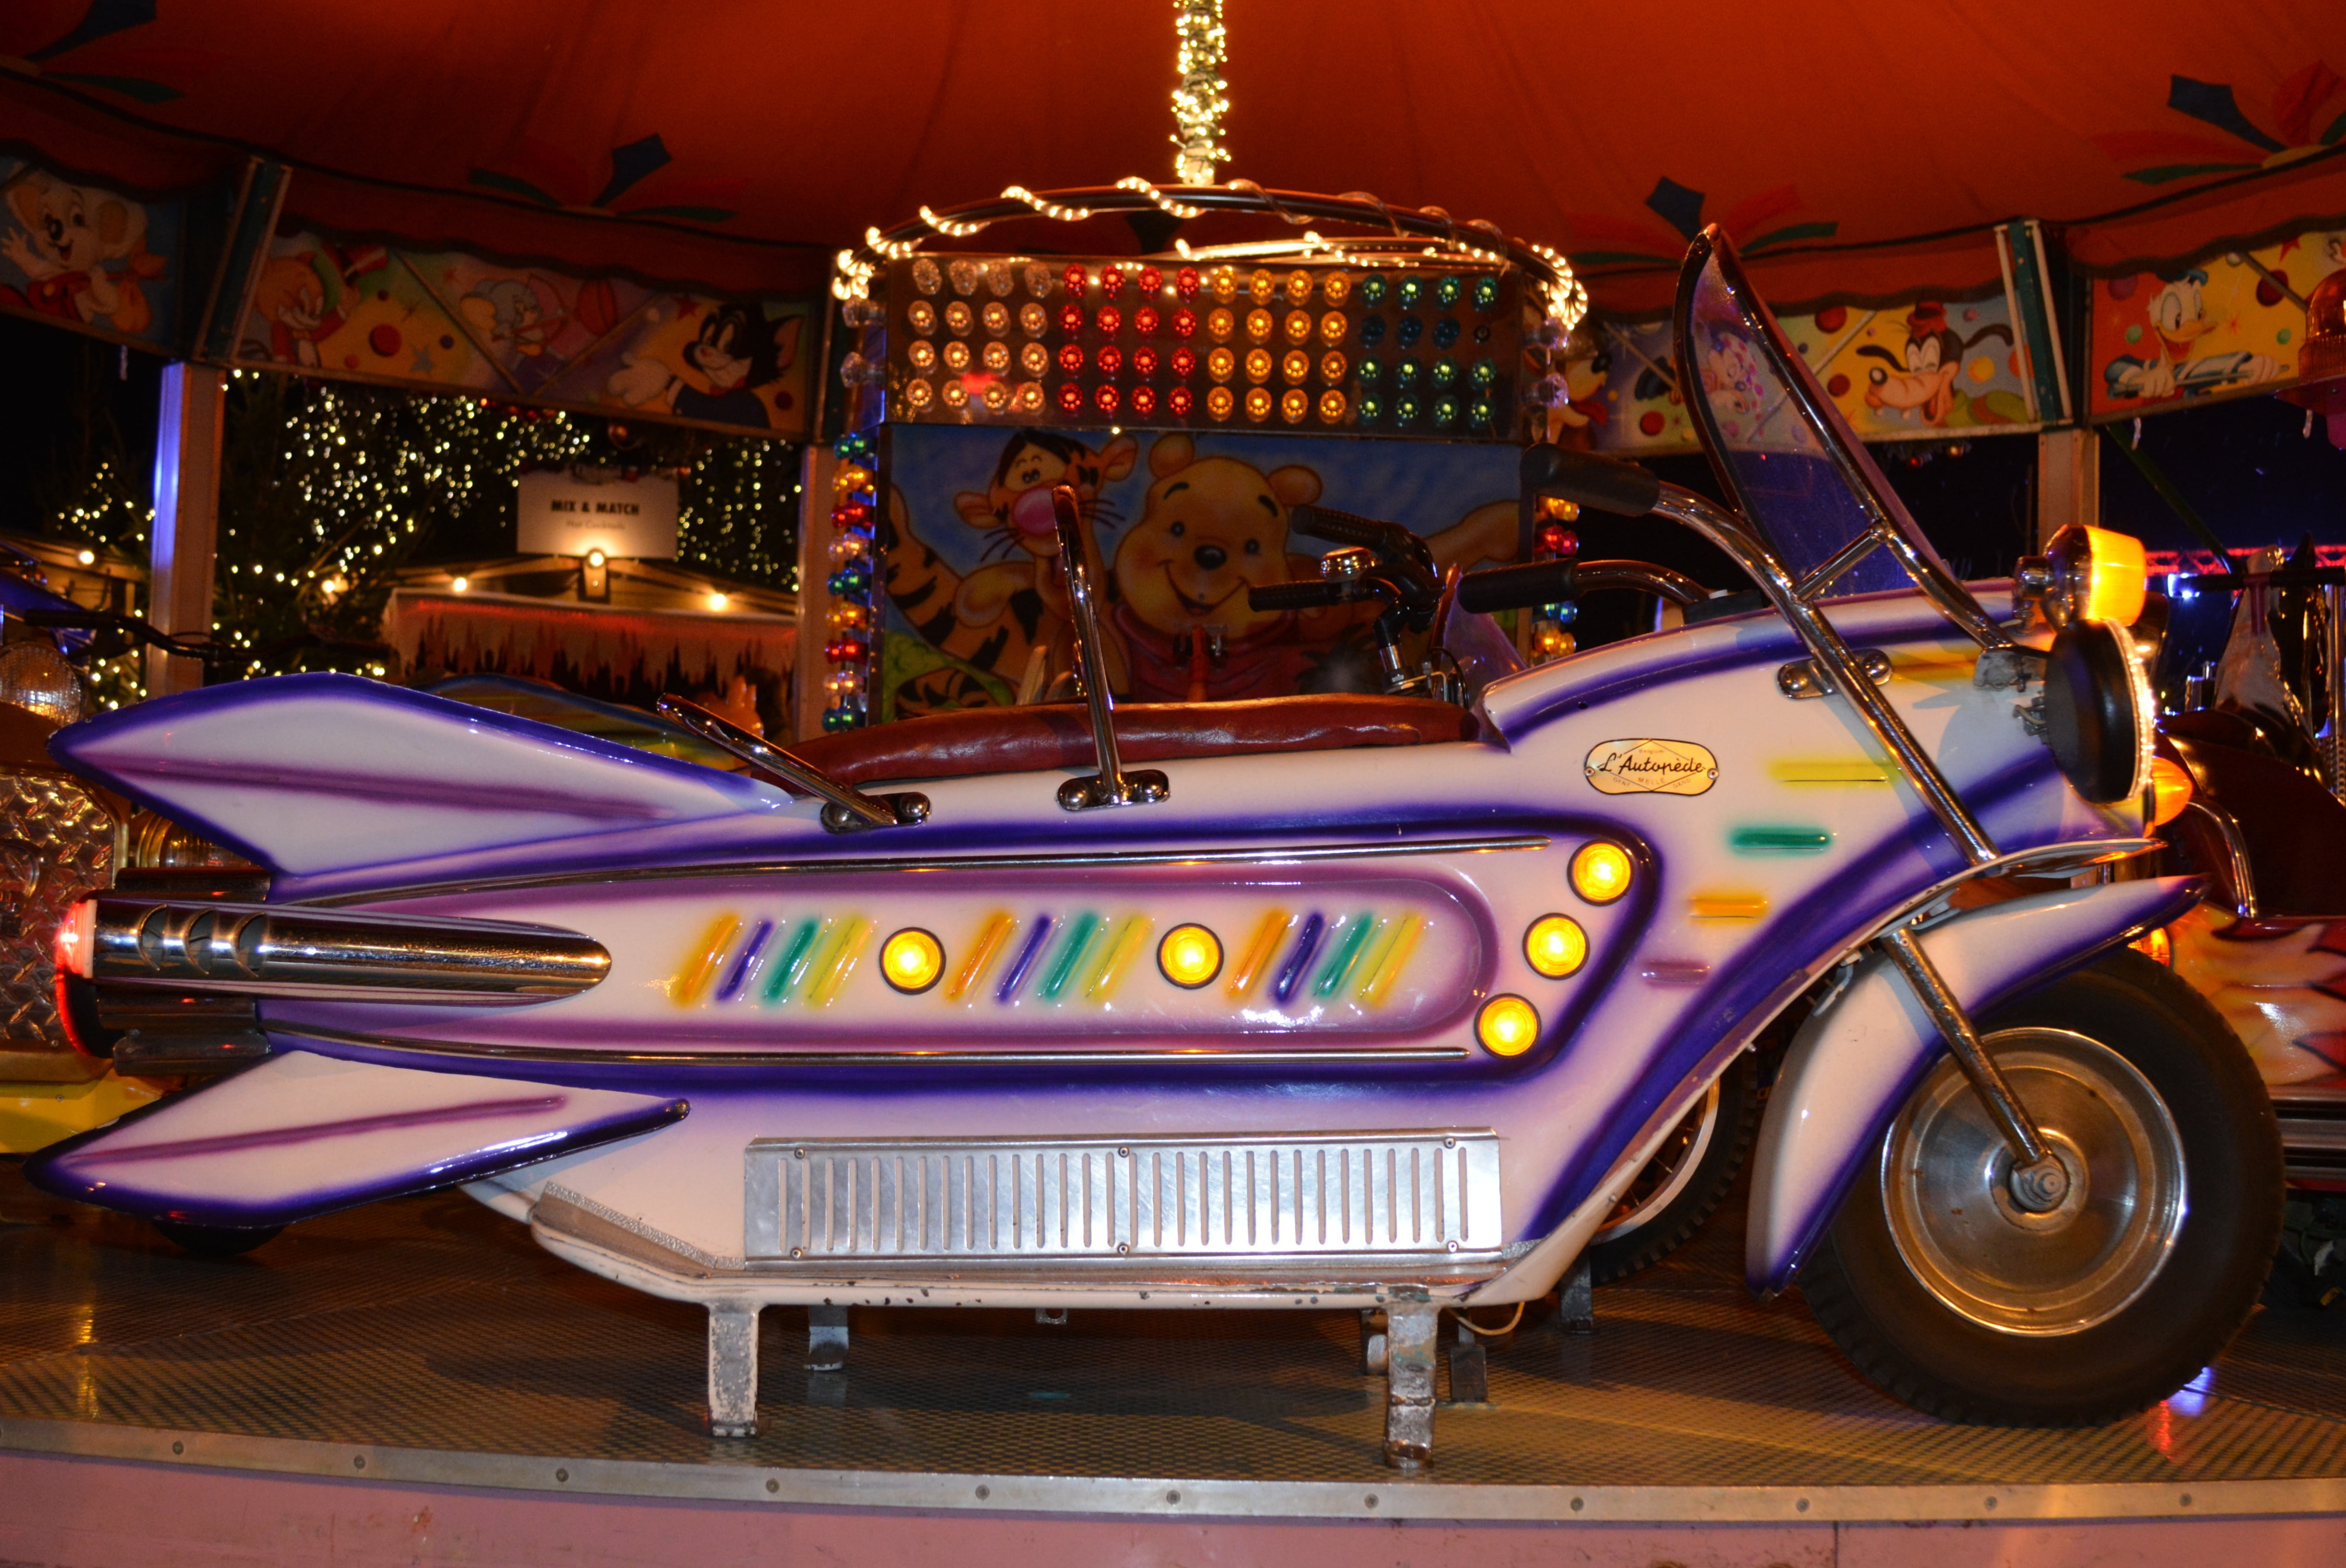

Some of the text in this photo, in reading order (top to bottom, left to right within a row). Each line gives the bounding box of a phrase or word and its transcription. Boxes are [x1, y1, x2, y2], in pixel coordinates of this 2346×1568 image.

[551, 500, 639, 515] MIX & MATCH
[1613, 777, 1630, 787] GENT
[1673, 778, 1691, 788] GAND
